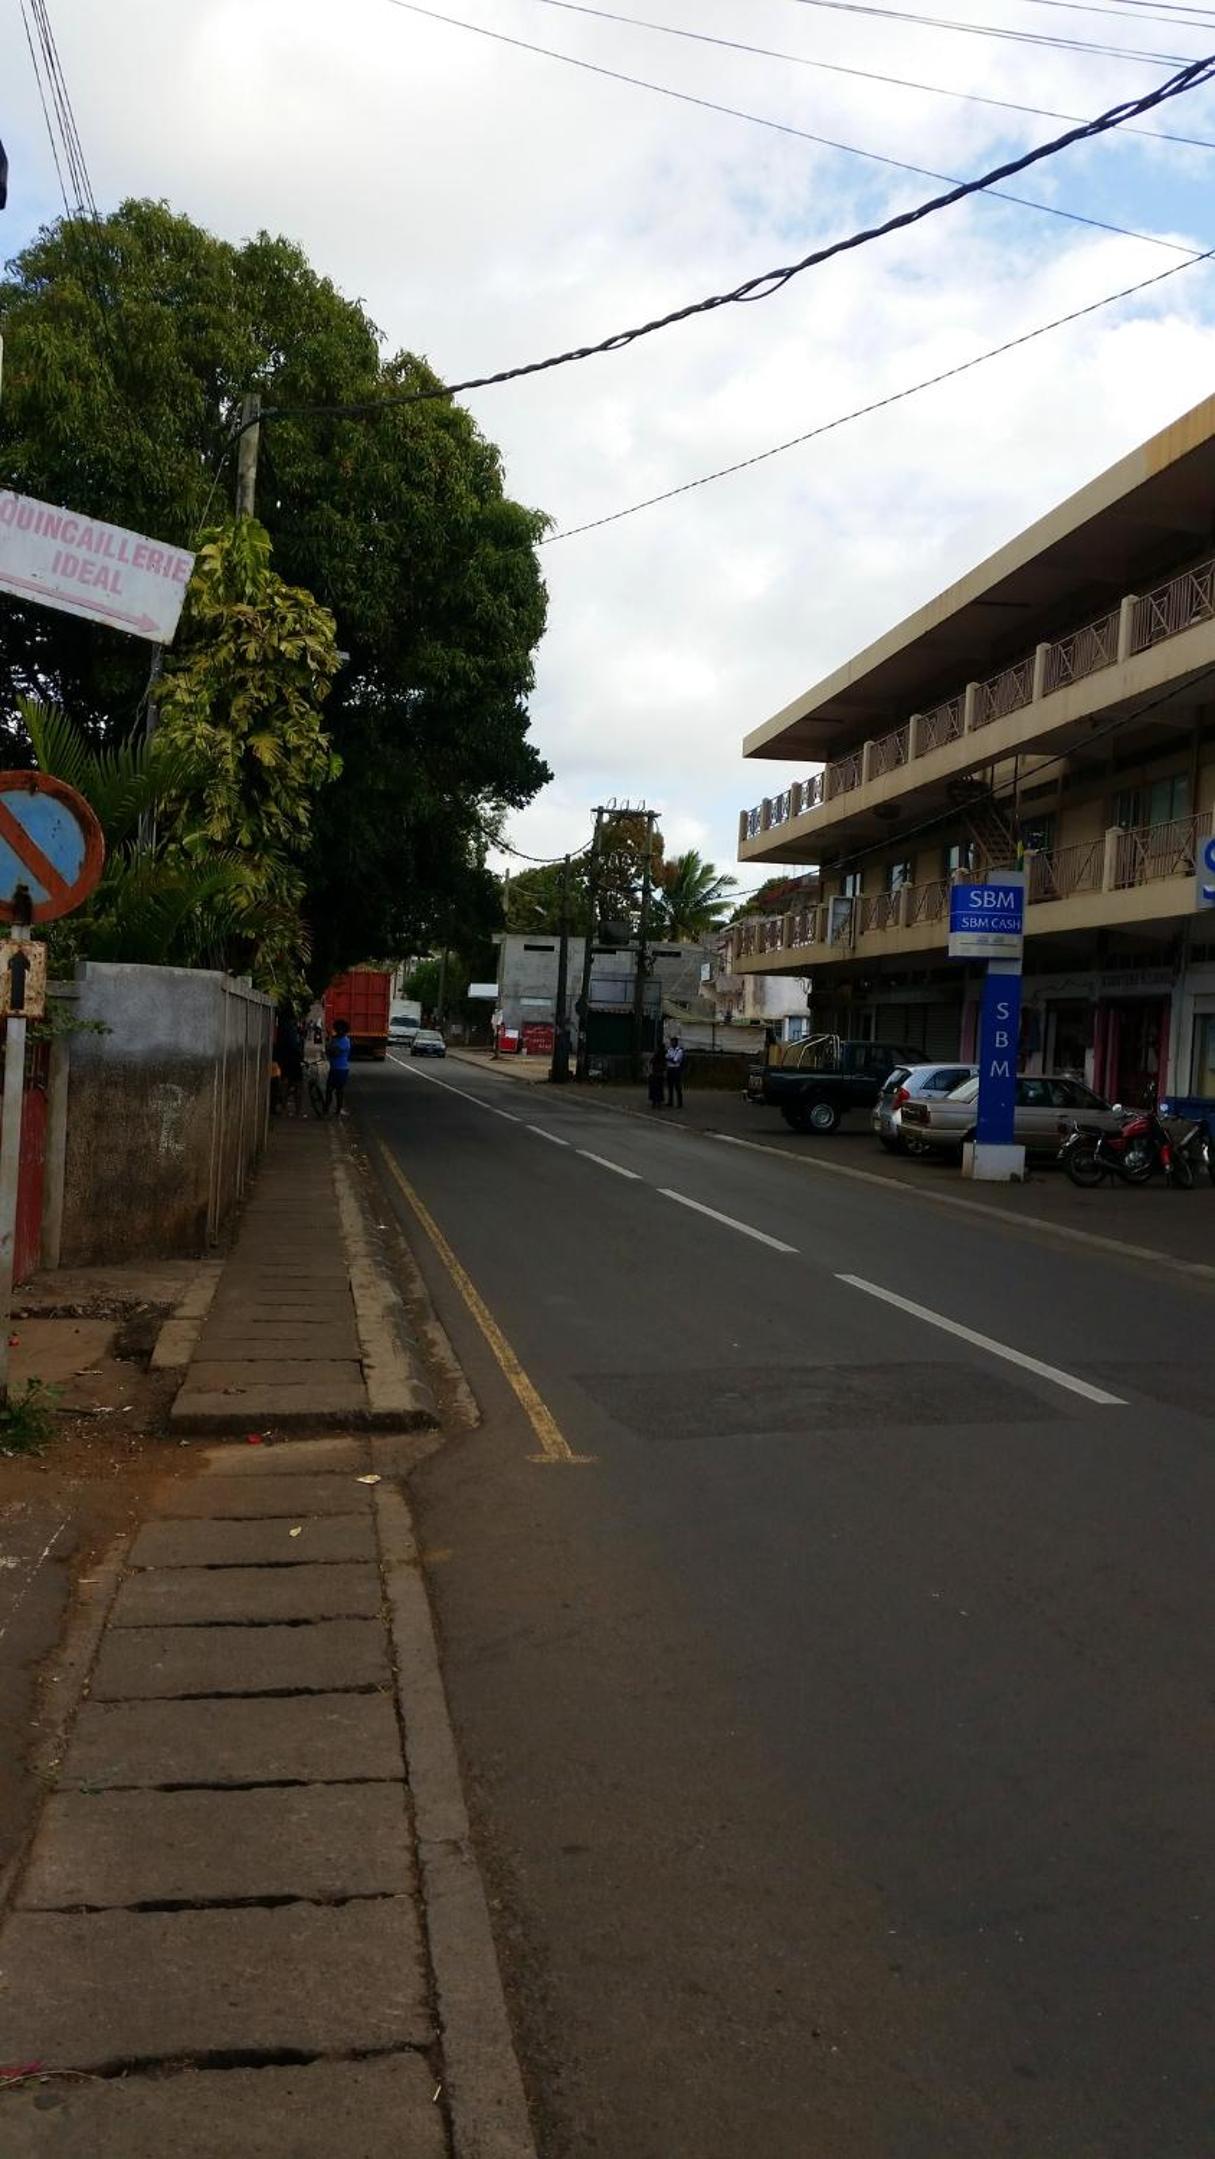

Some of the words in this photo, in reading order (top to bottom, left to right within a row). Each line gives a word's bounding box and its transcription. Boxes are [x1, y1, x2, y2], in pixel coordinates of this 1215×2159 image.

[0, 499, 190, 584] QUINCAILLERIE
[52, 551, 123, 595] IDEAL
[968, 890, 1015, 909] SBM
[961, 917, 989, 928] SBM
[991, 918, 1020, 930] CASH
